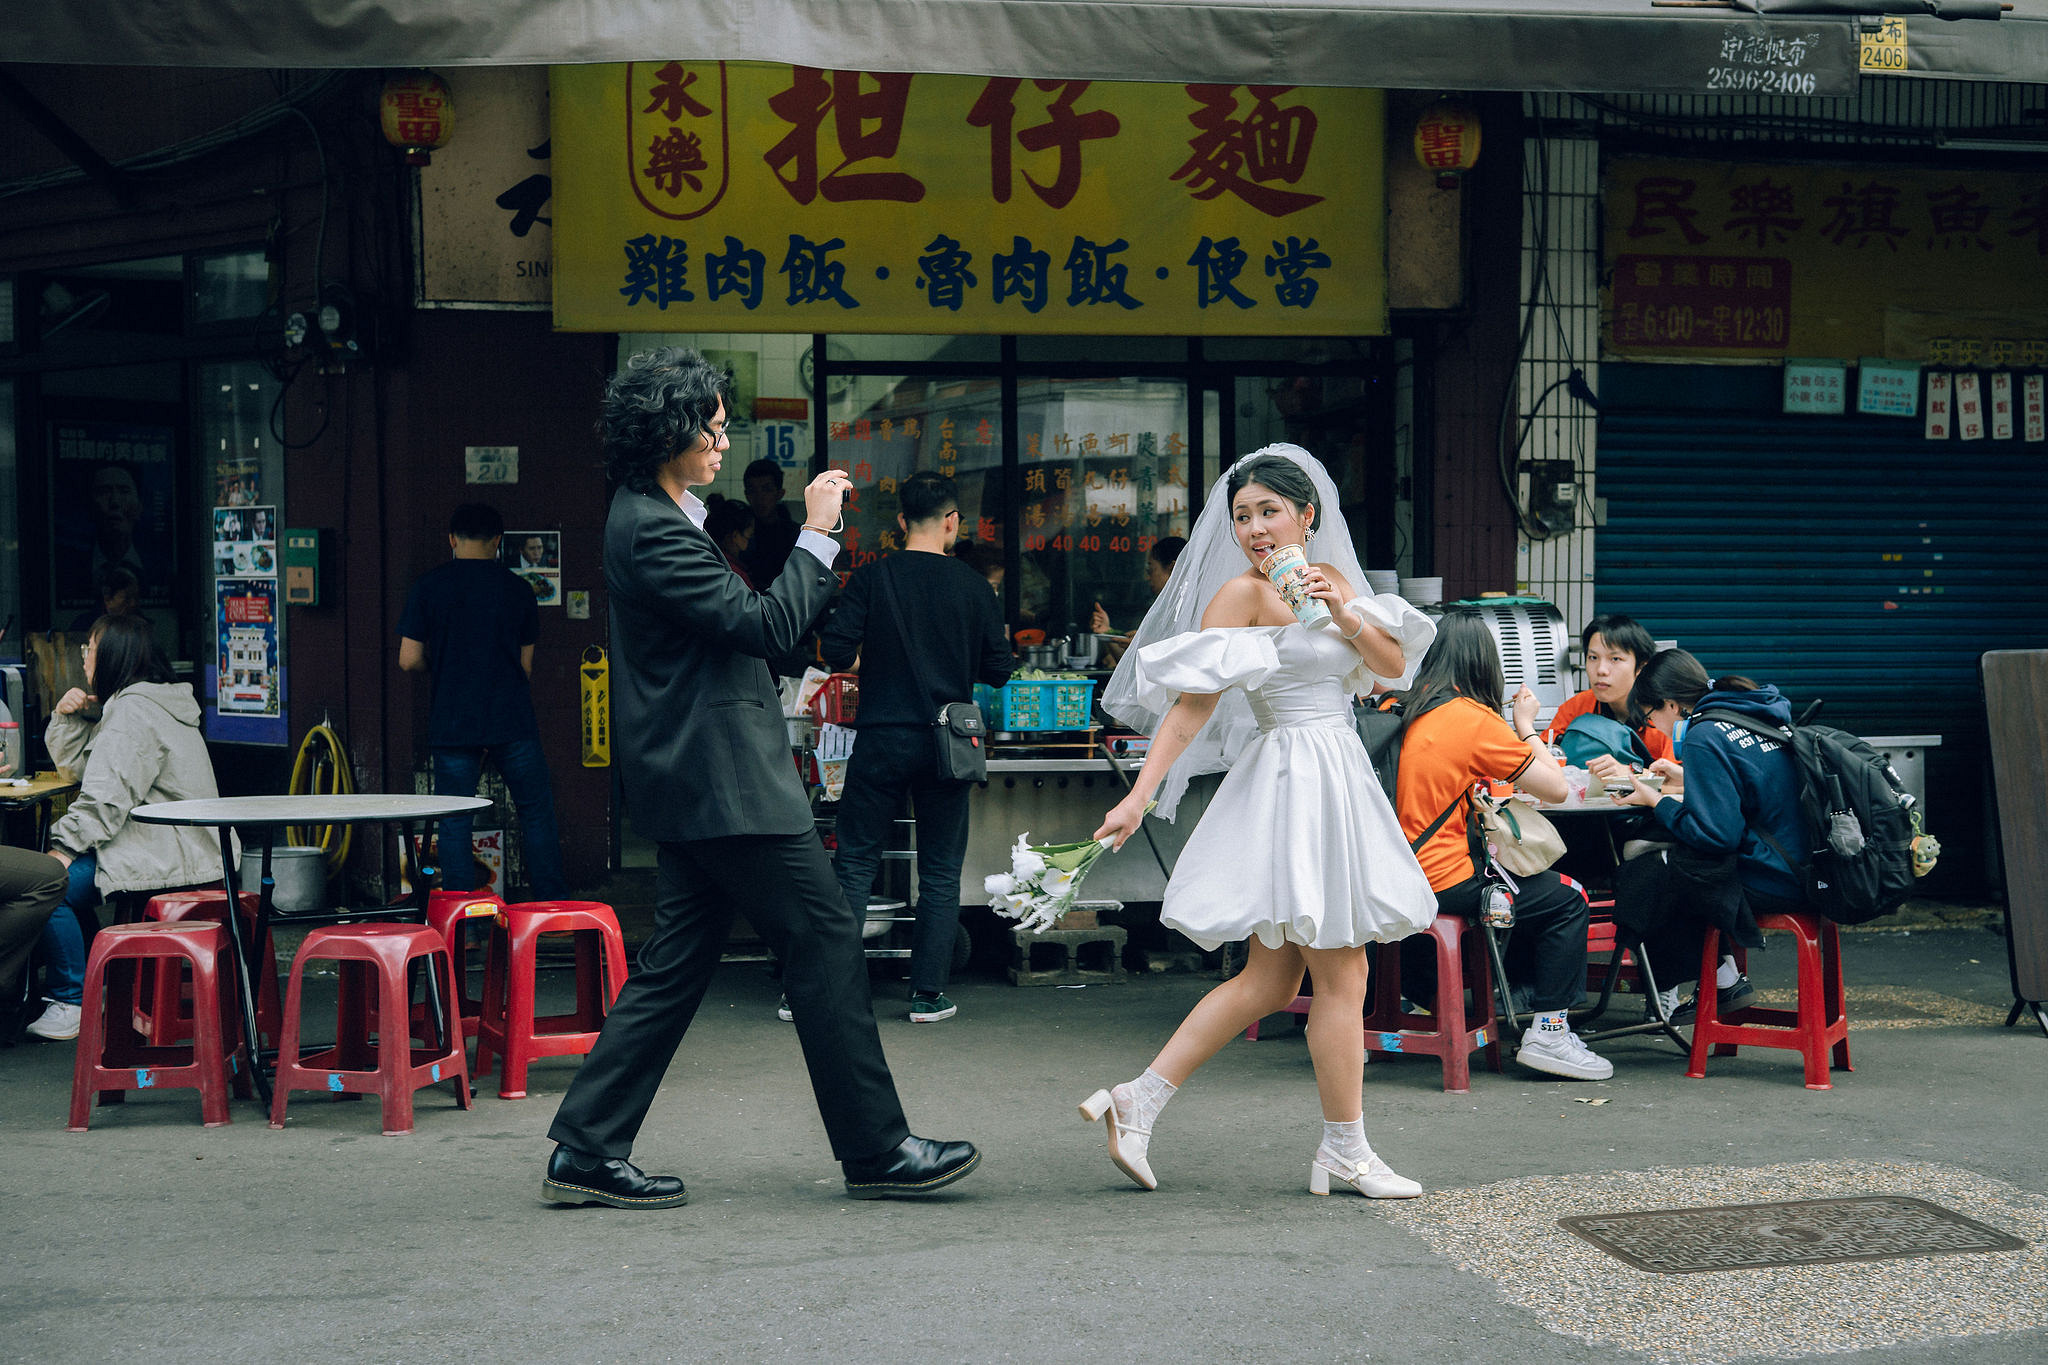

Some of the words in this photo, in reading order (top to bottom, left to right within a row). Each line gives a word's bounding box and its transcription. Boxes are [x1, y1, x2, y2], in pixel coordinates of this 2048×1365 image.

[1864, 47, 1902, 66] 2406
[643, 61, 713, 199] 永樂
[516, 261, 552, 277] SIN
[1635, 263, 1773, 289] 營業時間
[765, 425, 794, 460] 15
[1025, 535, 1046, 551] 40
[1052, 535, 1073, 551] 40
[1079, 535, 1101, 551] 40
[1109, 537, 1130, 552] 40
